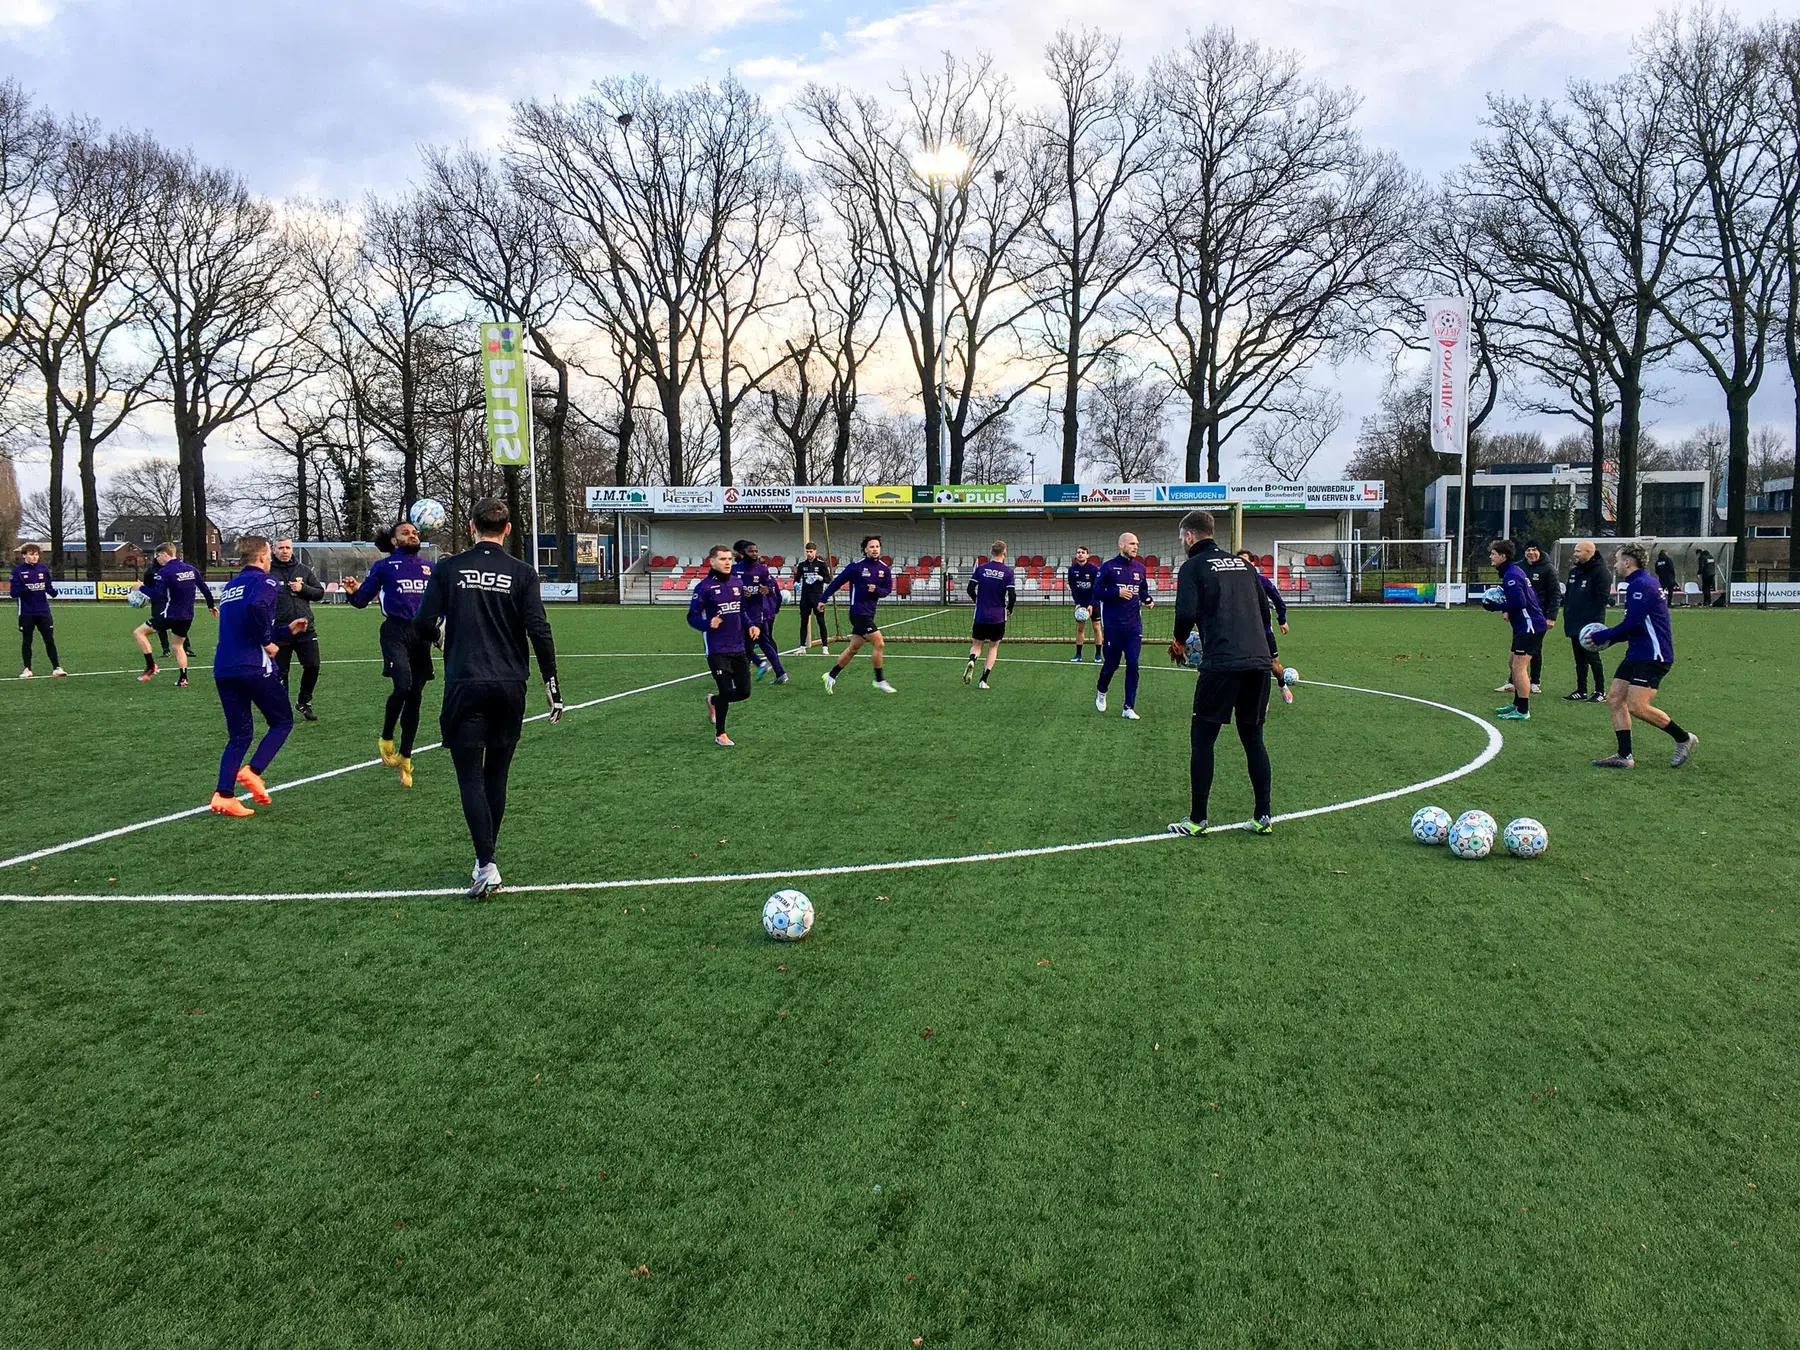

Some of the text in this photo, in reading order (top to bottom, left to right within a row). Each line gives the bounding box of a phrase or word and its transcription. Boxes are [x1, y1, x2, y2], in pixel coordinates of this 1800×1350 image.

[1265, 484, 1304, 492] Boomen
[1307, 485, 1355, 493] BOUWBEDRIJF
[741, 488, 791, 497] JANSSENS
[1170, 492, 1217, 500] VERBRUGGEN
[662, 491, 713, 504] WESTEN
[795, 495, 861, 503] ADRIAANS B.V.
[966, 493, 1005, 503] PLUS
[1307, 494, 1320, 502] VAN
[1321, 494, 1349, 502] GERVEN
[1207, 558, 1246, 568] DGS
[458, 569, 513, 588] DGS
